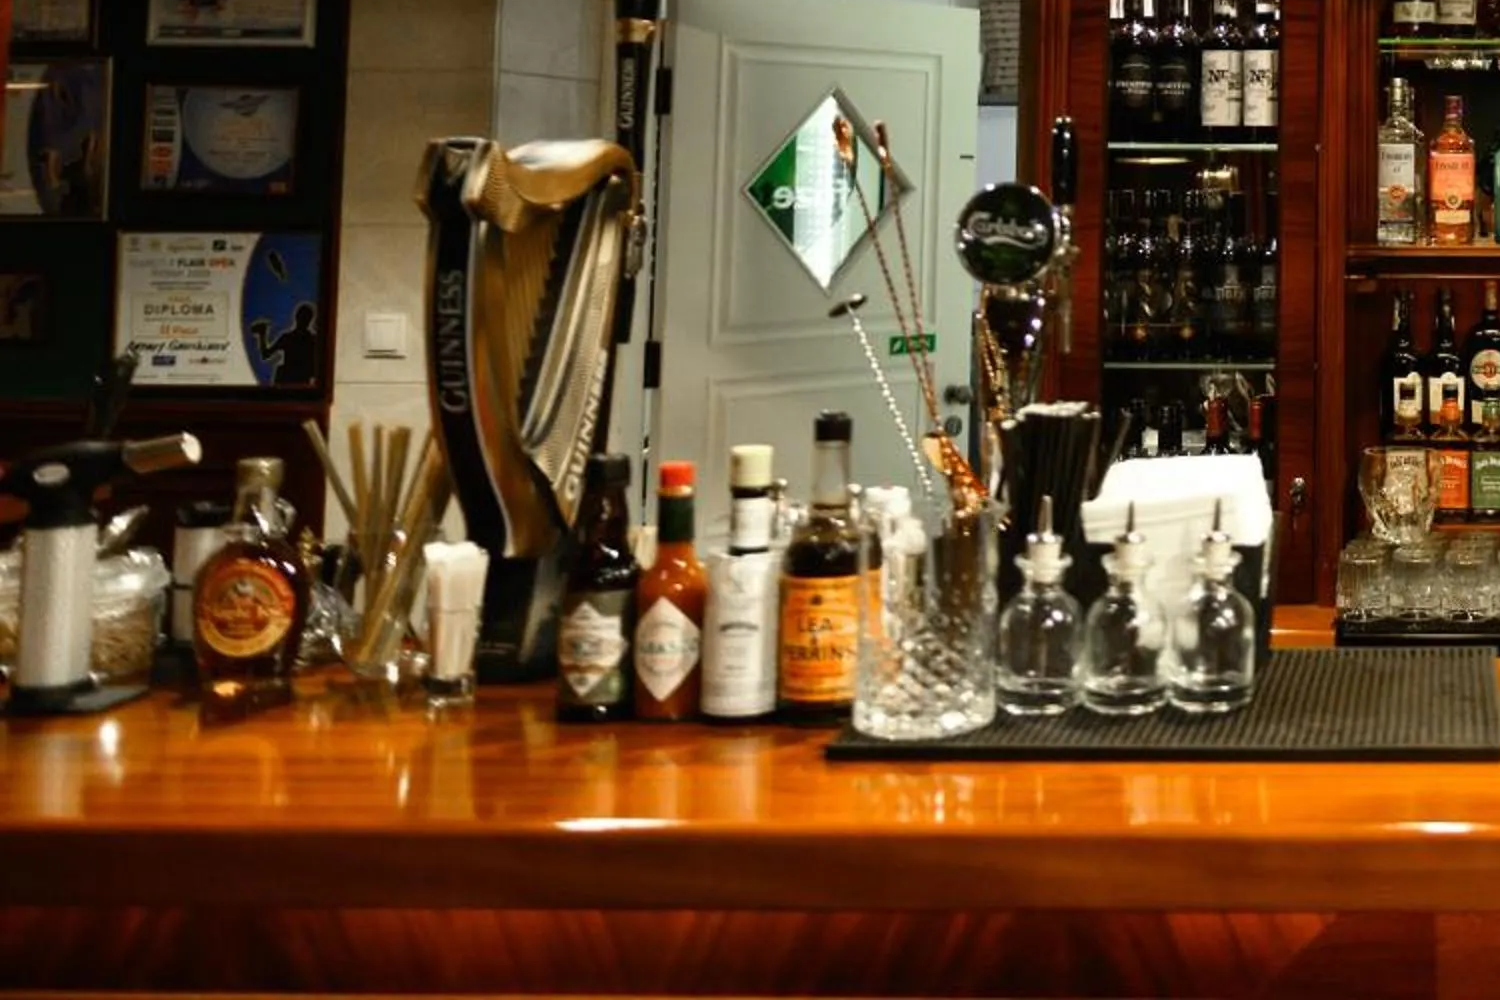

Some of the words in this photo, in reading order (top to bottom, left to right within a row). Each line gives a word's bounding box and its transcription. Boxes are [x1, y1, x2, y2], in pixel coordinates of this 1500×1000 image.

[617, 56, 638, 131] GUINNESS
[143, 303, 215, 316] DIPLOMA
[440, 268, 466, 415] GUINNESS
[797, 616, 833, 633] LEA
